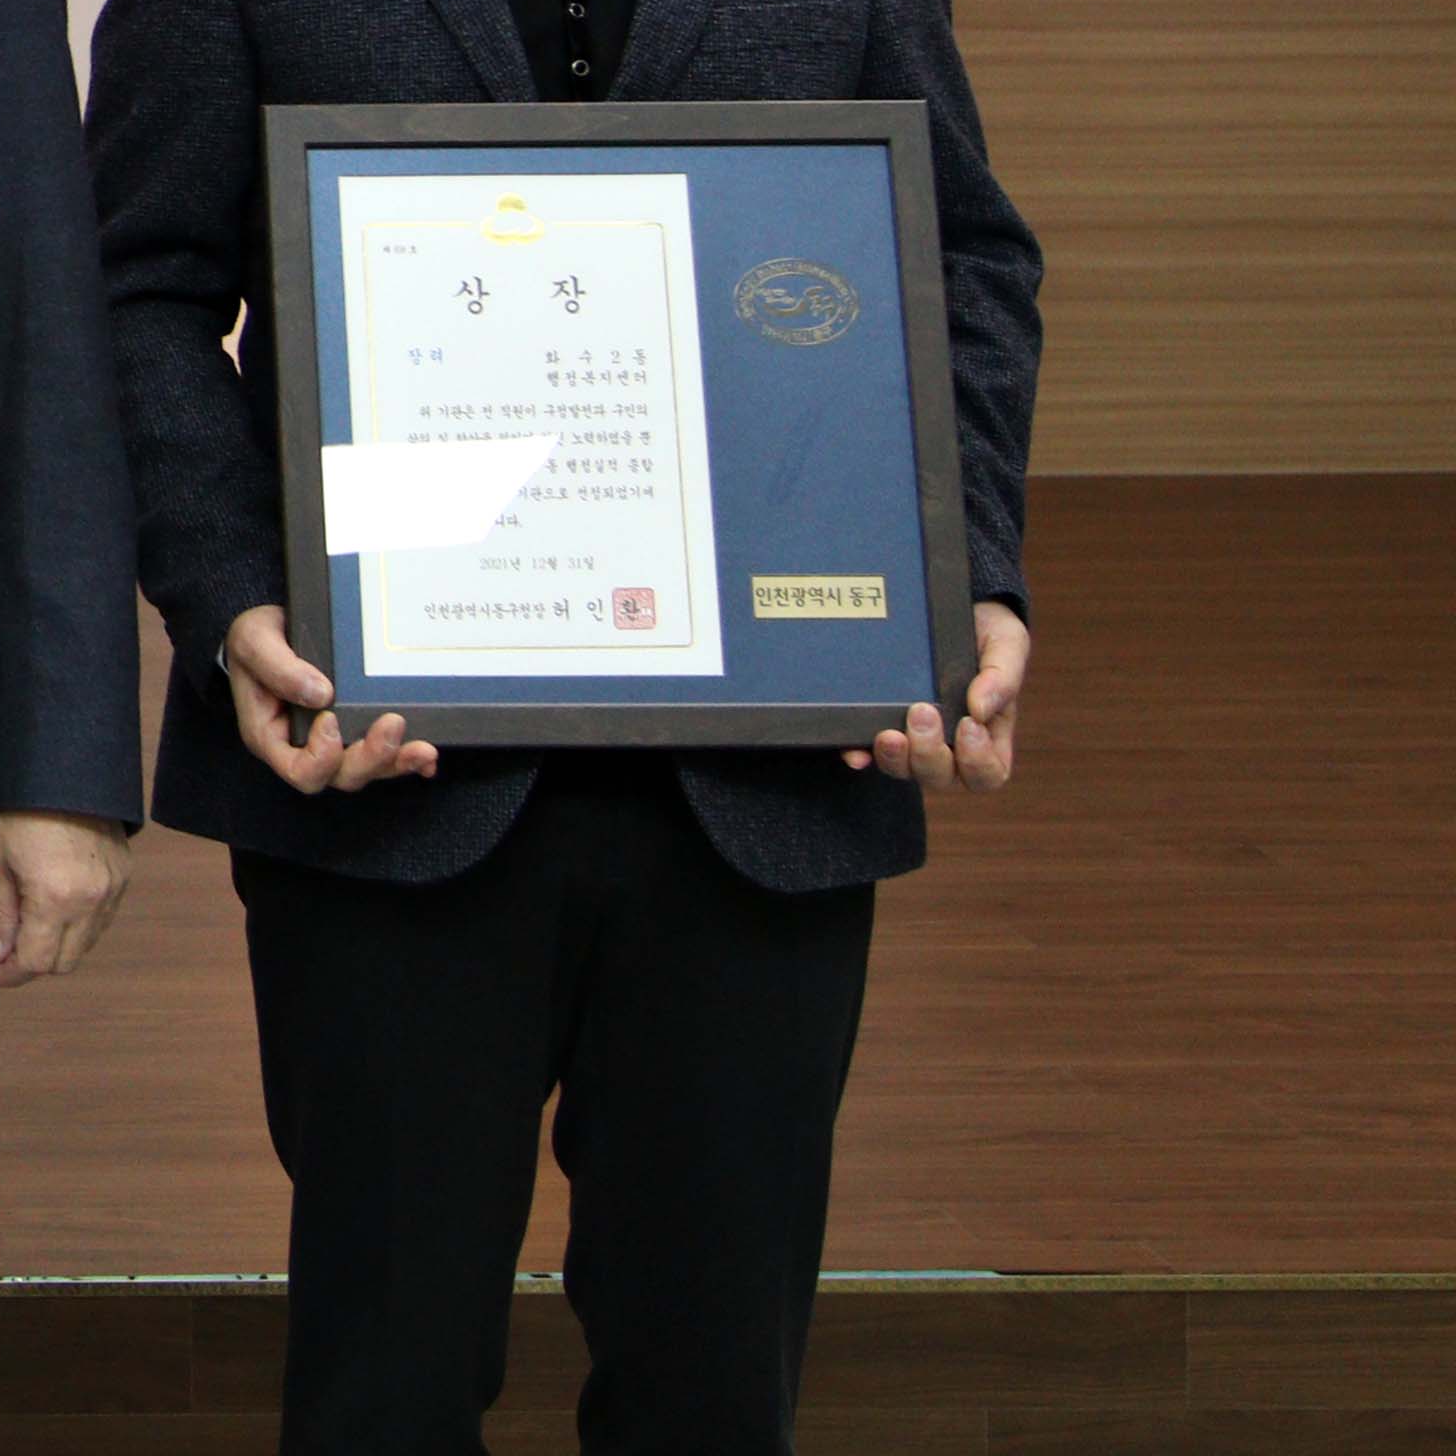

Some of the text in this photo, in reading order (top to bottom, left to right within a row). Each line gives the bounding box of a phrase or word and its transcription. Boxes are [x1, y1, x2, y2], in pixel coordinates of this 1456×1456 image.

[453, 275, 587, 315] 상 장
[755, 586, 882, 608] 인천광역시 동구
